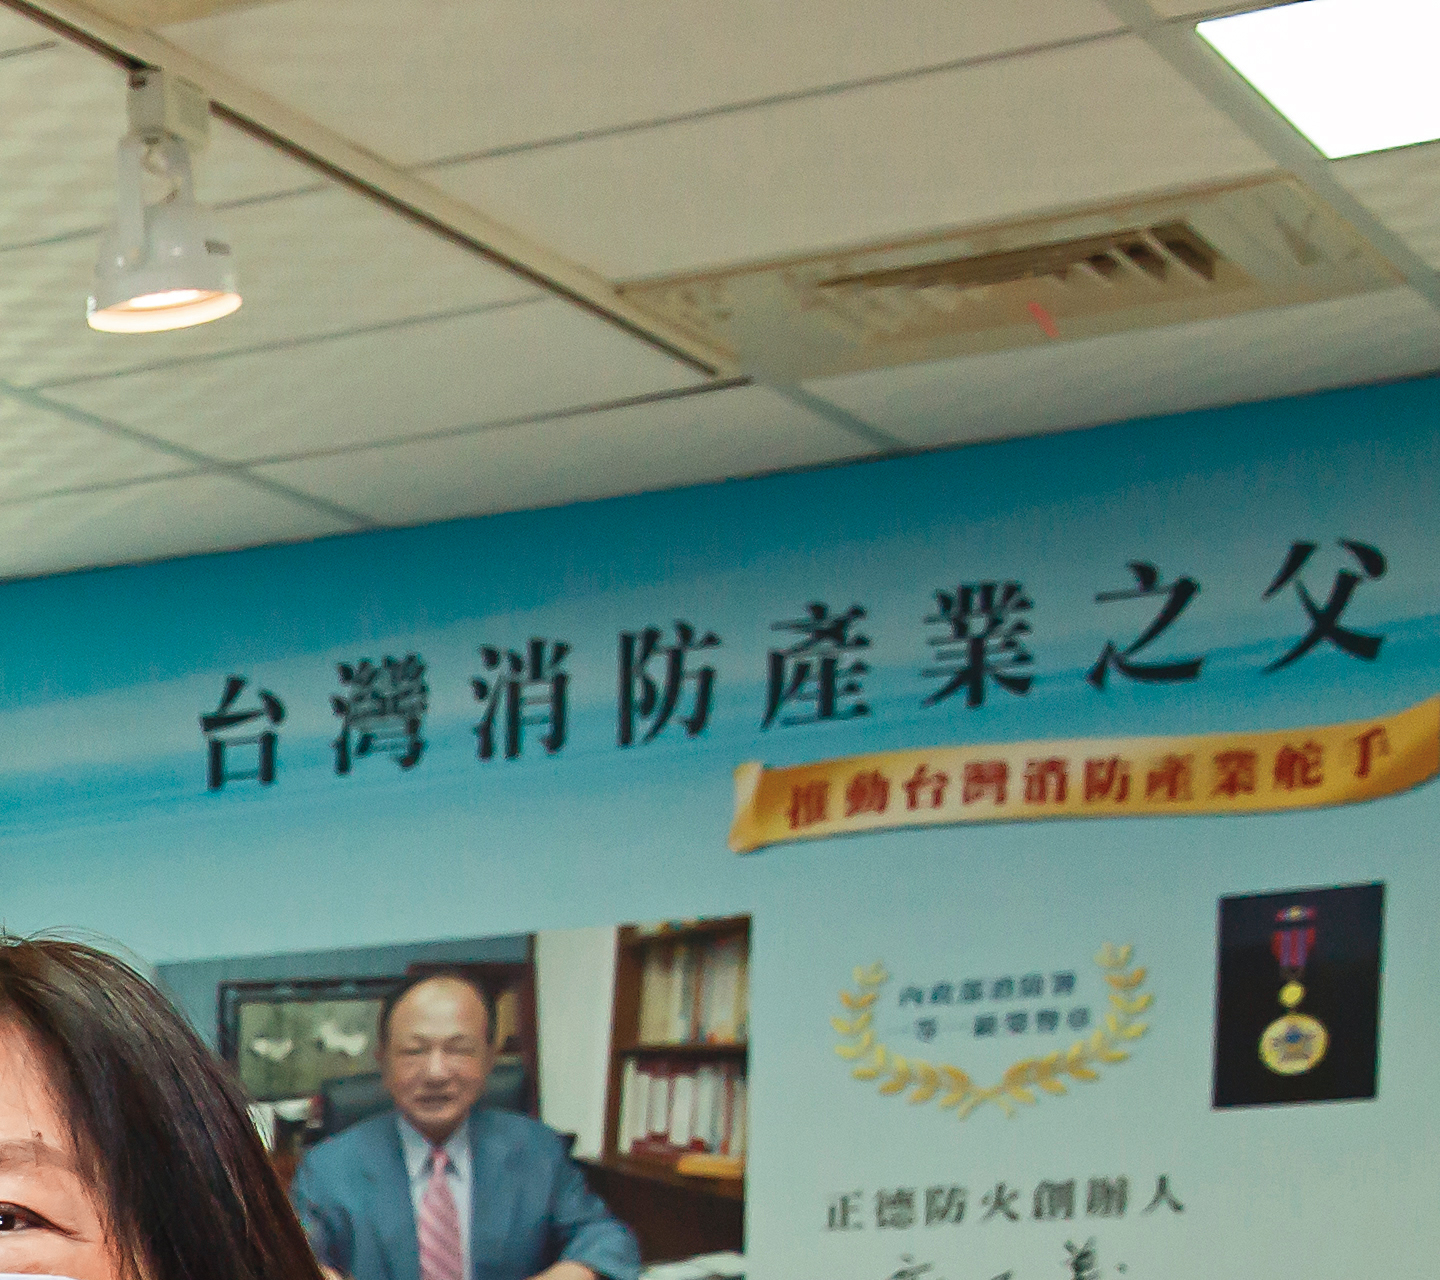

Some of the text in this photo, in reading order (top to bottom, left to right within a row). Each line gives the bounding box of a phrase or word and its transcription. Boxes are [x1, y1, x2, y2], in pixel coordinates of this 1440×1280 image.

[197, 537, 1389, 793] 台灣消防產業之父
[822, 1173, 1185, 1233] 正德防火創辦人
